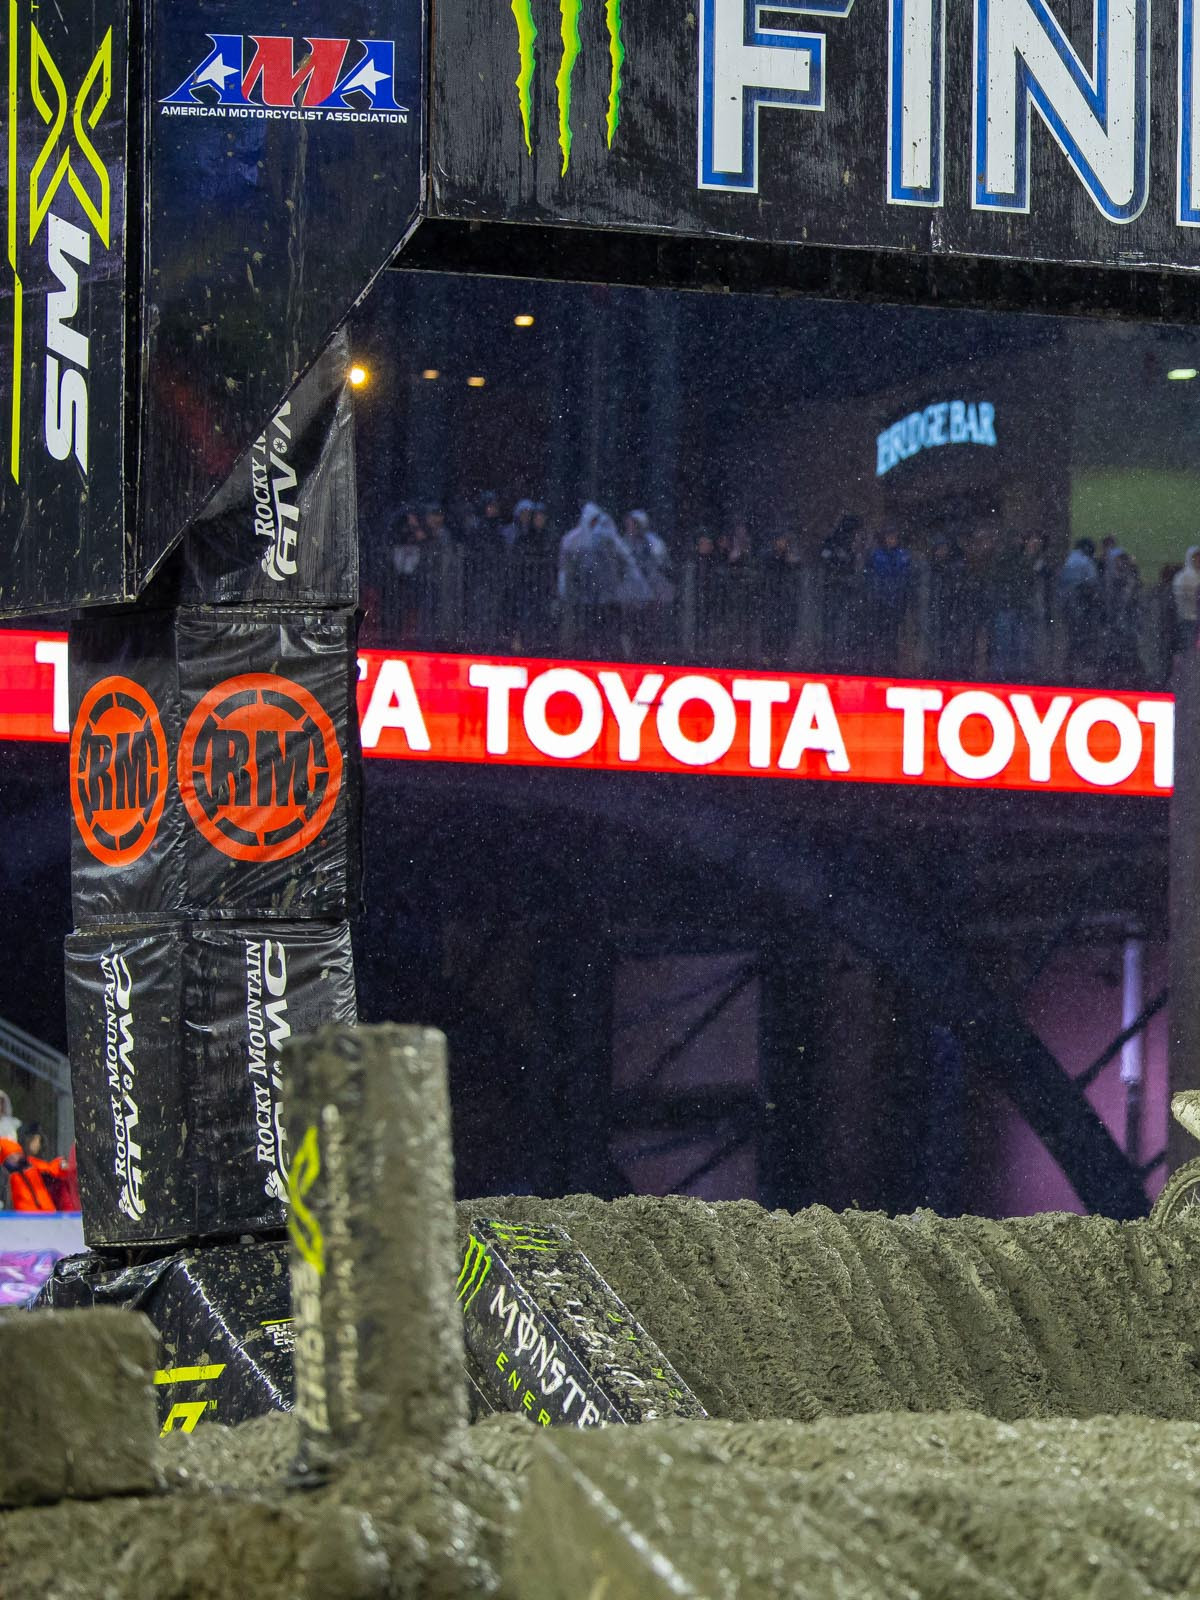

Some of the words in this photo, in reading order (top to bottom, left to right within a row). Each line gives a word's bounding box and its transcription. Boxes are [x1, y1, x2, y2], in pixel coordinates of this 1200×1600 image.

[158, 33, 409, 111] AMA
[161, 106, 226, 118] AMERICAN
[229, 108, 323, 121] MOTORCYCLIST
[326, 112, 408, 124] ASSOCIATION
[949, 399, 997, 447] BAR
[251, 457, 276, 540] ROCKY
[469, 664, 850, 772] TOYOTA
[100, 954, 121, 1092] MOUNTAIN
[245, 939, 268, 1078] MOUNTAIN
[111, 1094, 128, 1180] ROCKY
[254, 1082, 275, 1166] ROCKY
[489, 1285, 607, 1430] MONSTE
